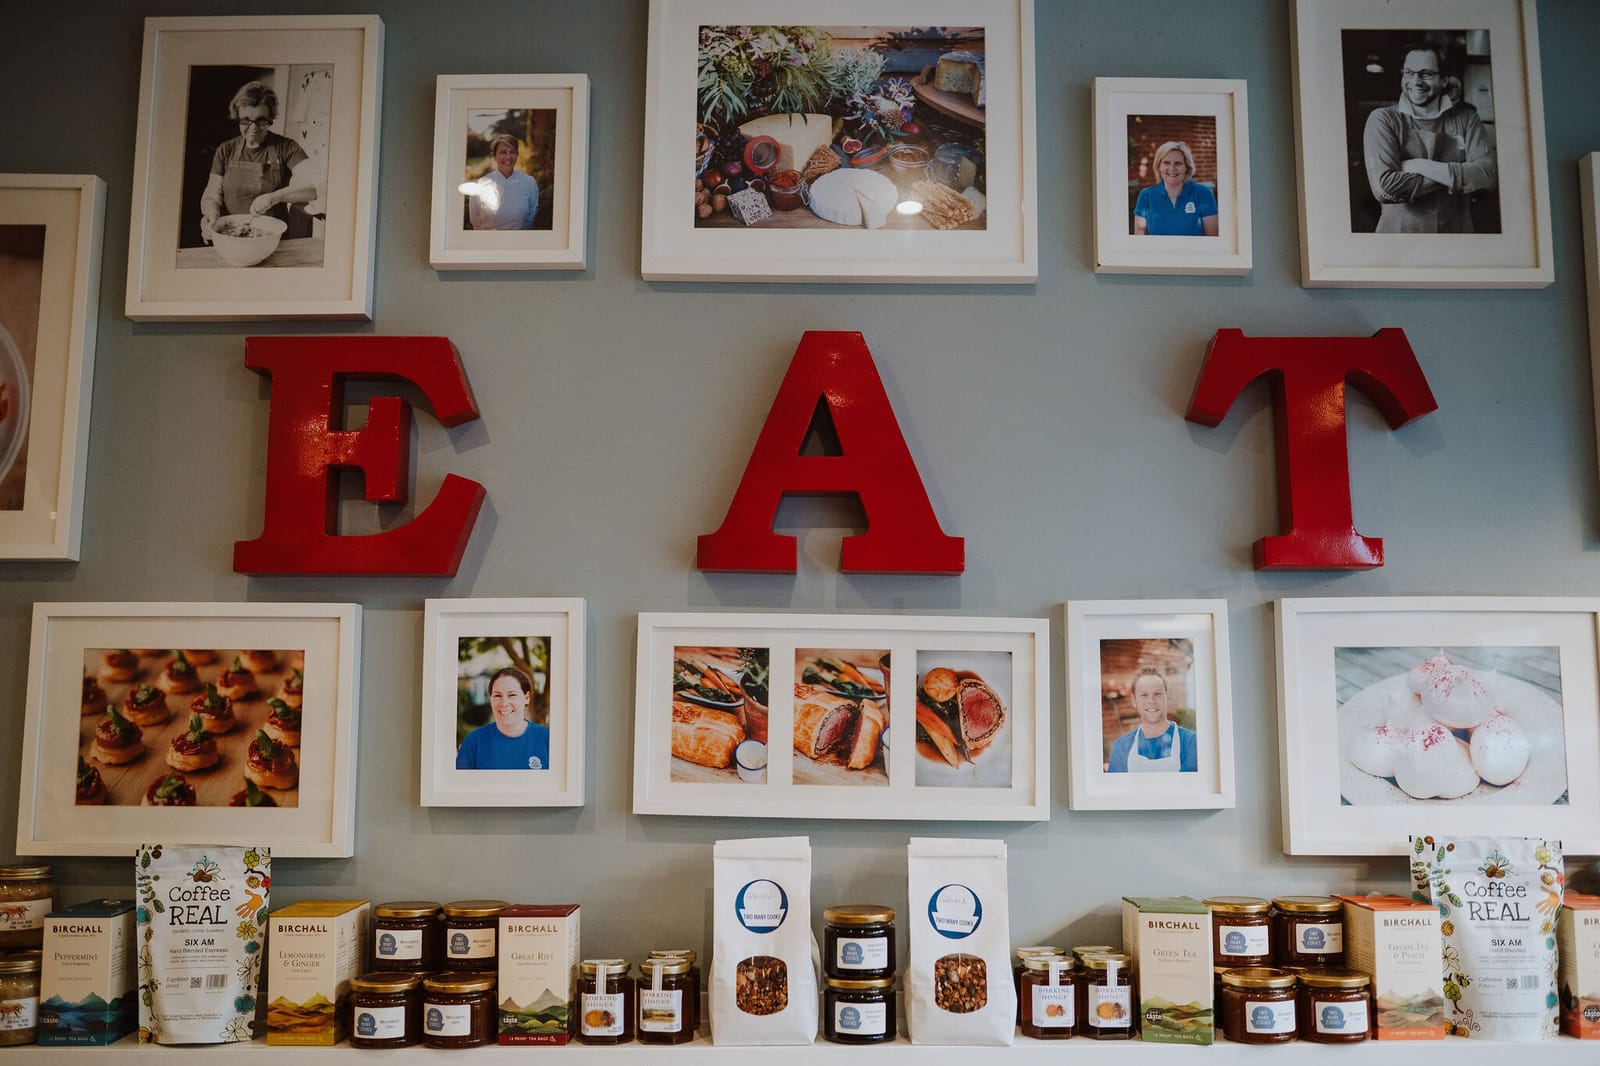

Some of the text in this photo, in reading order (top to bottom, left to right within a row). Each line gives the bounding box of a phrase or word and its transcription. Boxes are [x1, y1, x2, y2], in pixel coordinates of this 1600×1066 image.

[168, 885, 231, 902] Coffee
[1464, 881, 1527, 898] Coffee
[168, 905, 228, 925] REAL
[1467, 901, 1530, 921] REAL
[1148, 921, 1200, 930] BIRCHALL
[1384, 918, 1432, 927] BIRCHALL
[52, 925, 103, 933] BIRCHALL
[278, 925, 328, 933] BIRCHALL
[508, 925, 558, 933] BIRCHALL
[43, 1016, 59, 1024] taste
